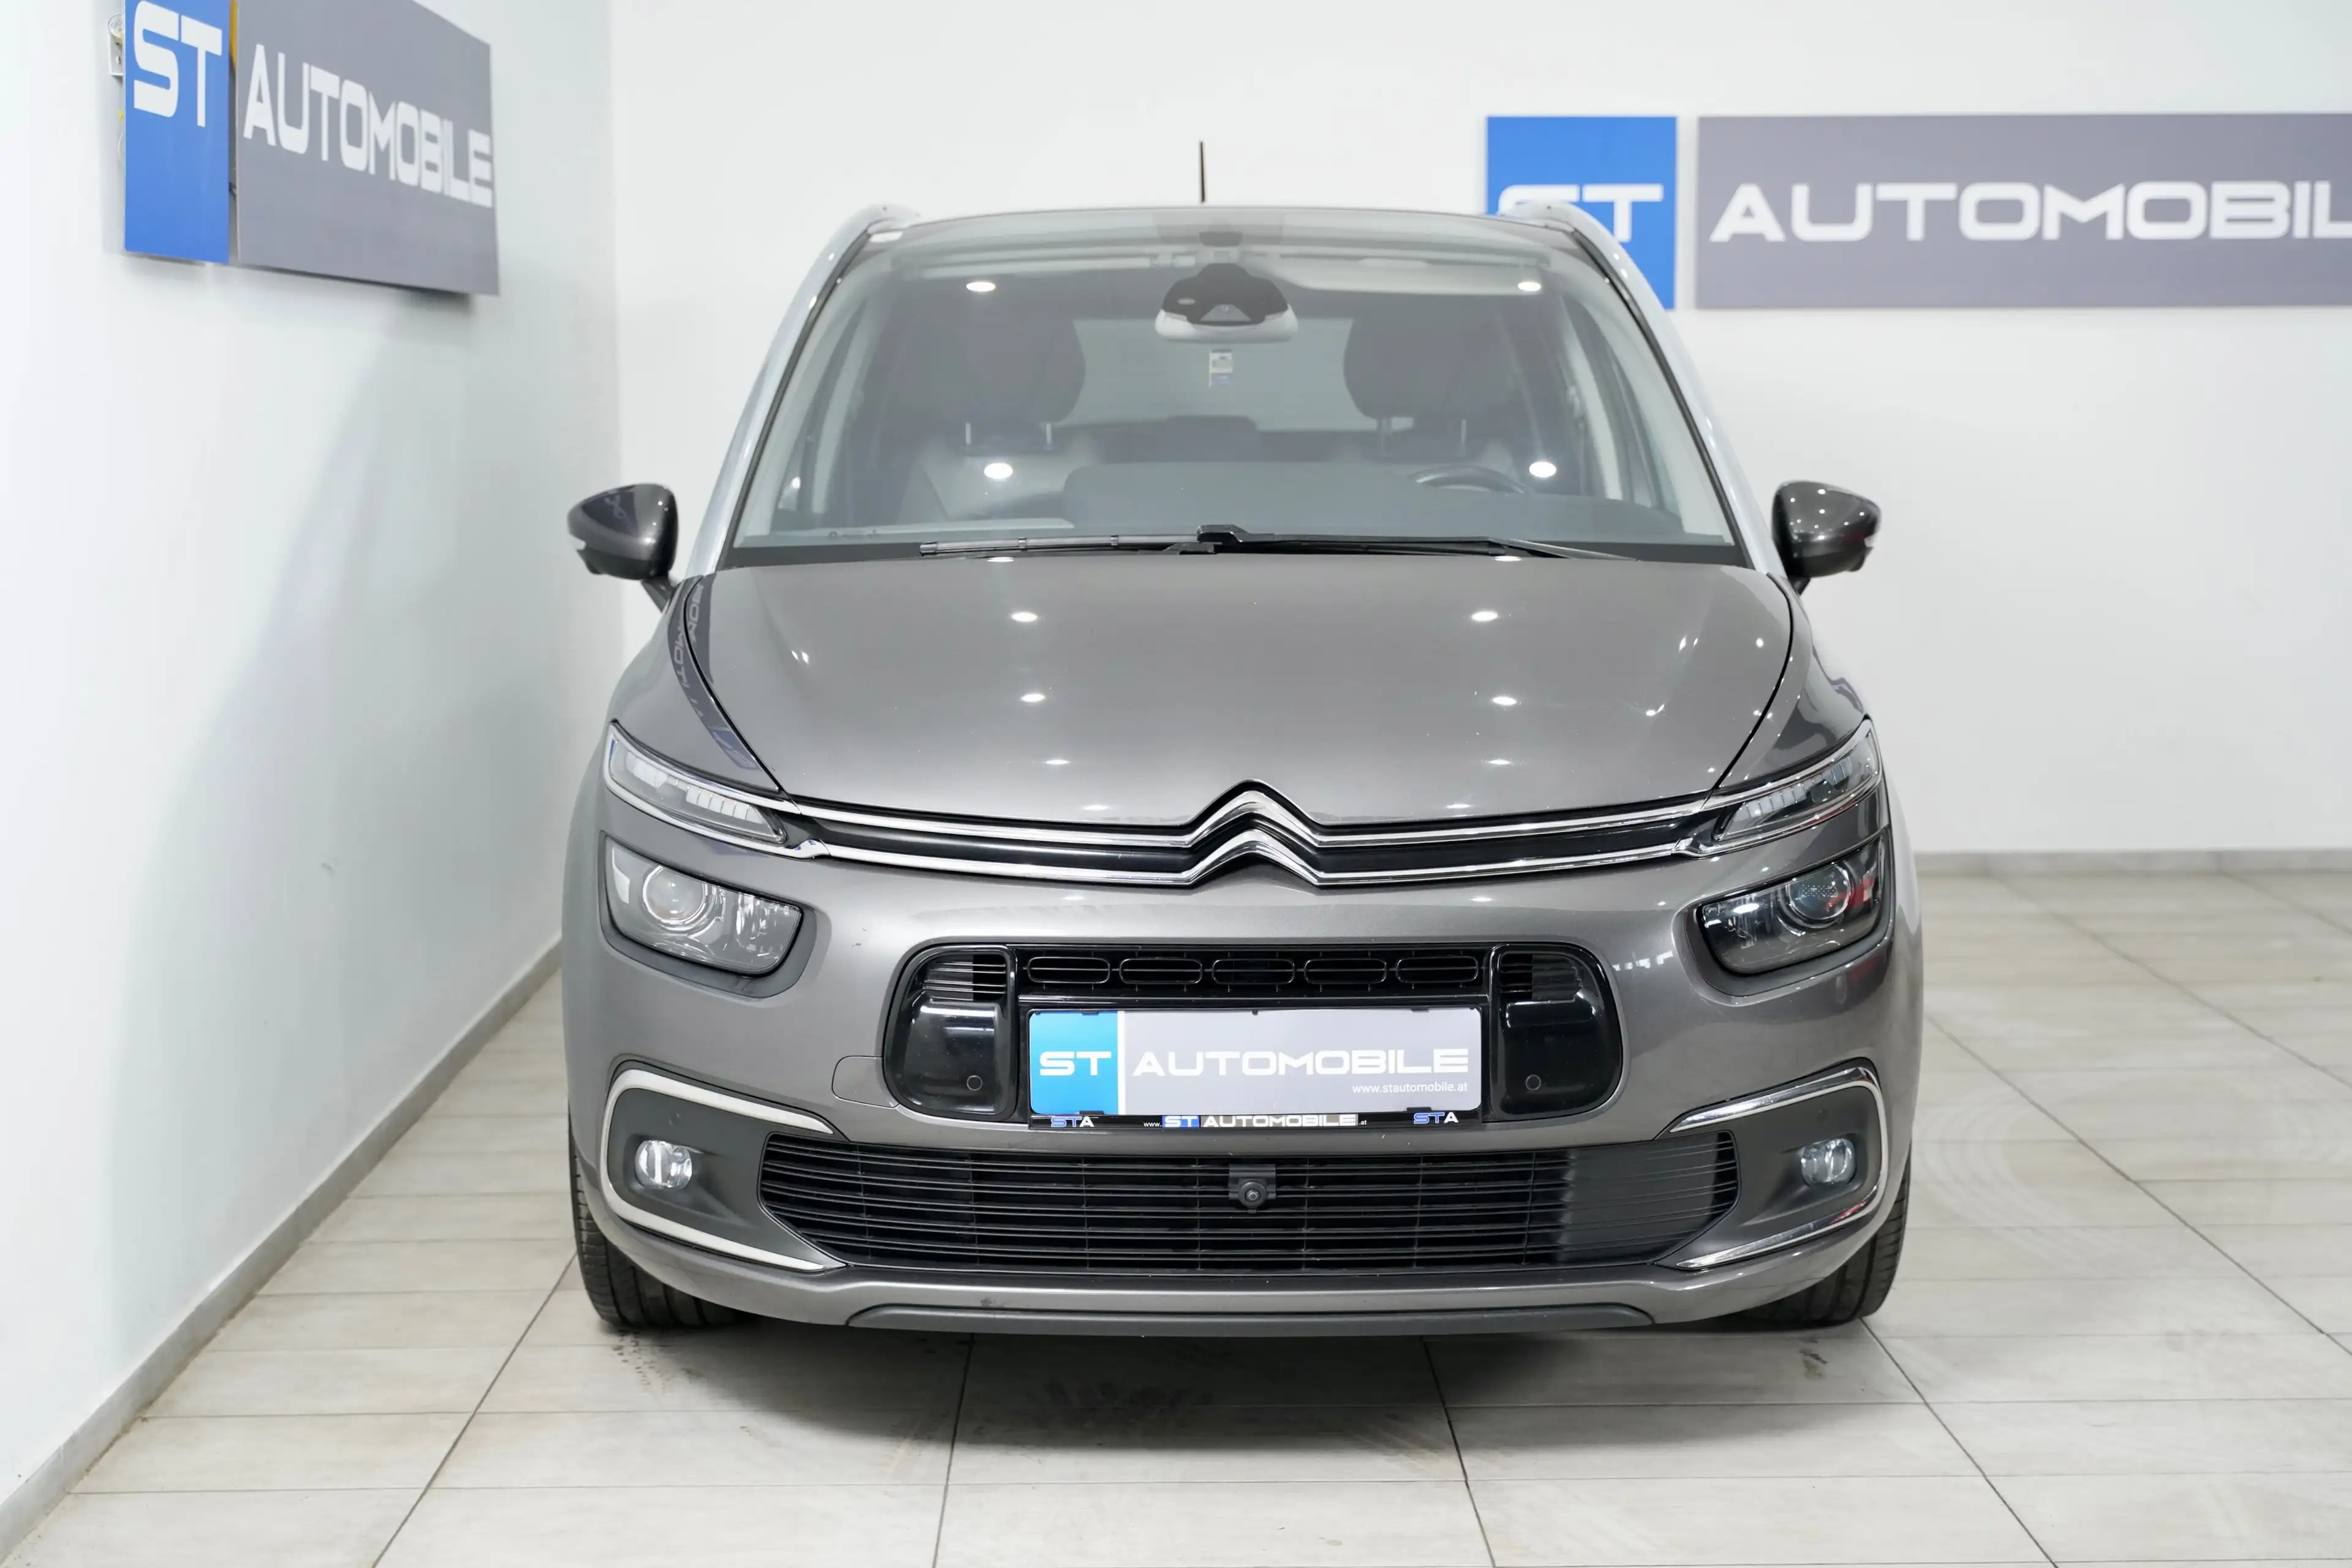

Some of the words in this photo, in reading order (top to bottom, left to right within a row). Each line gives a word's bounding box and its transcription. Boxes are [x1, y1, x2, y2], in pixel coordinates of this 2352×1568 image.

[134, 1, 222, 127] ST
[244, 43, 492, 208] AUTOMOBILE
[1039, 1051, 1112, 1076] ST
[1133, 1048, 1469, 1076] AUTOMOBILE
[1352, 1082, 1468, 1093] www.stautomobile.at
[1050, 1116, 1095, 1128] STA
[1413, 1112, 1459, 1125] STA
